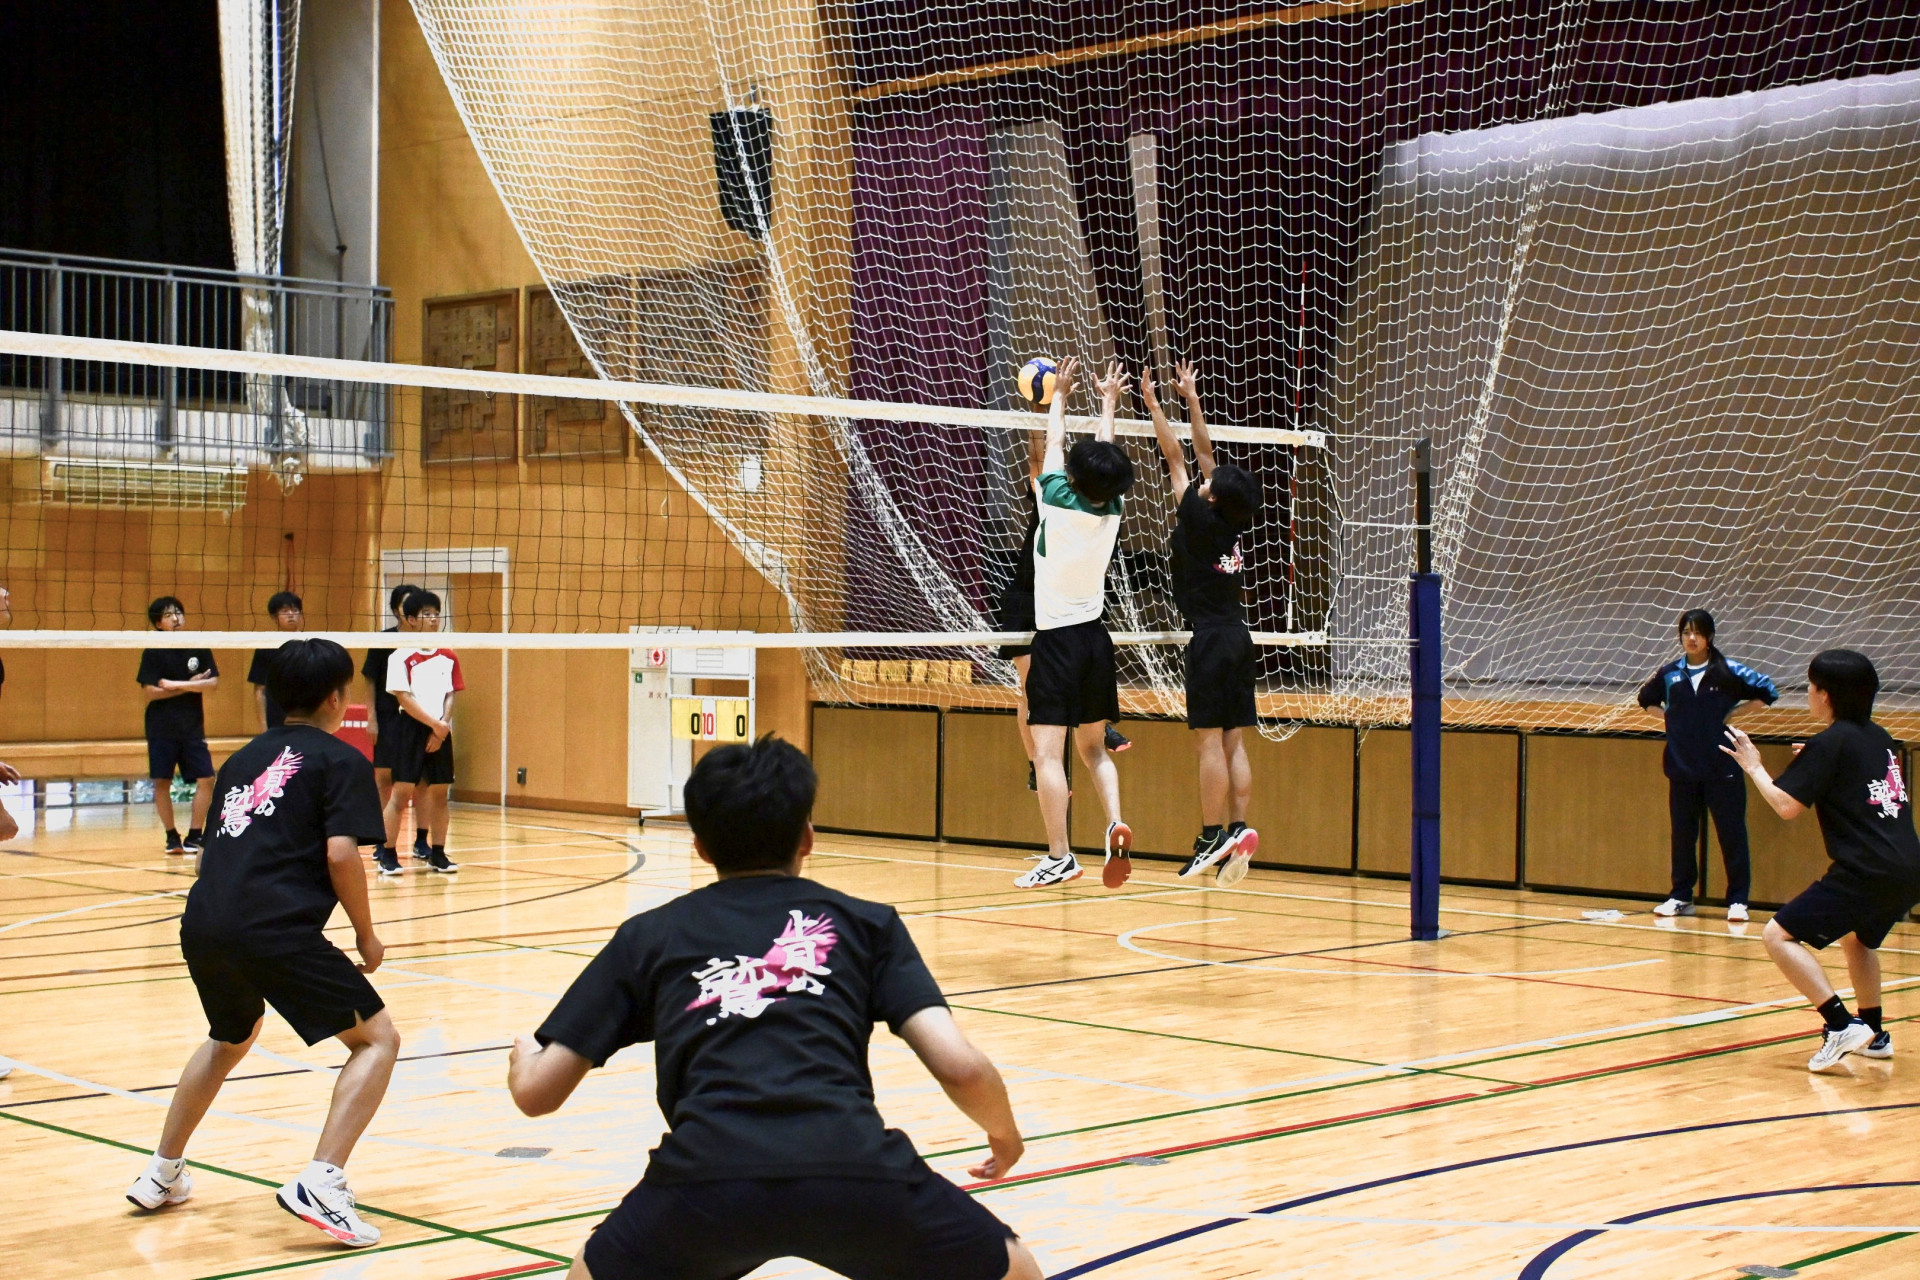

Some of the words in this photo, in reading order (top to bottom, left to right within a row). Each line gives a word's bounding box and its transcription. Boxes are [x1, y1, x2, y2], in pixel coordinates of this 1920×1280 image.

[690, 713, 700, 735] 0
[702, 713, 714, 735] 10
[736, 714, 746, 737] 0
